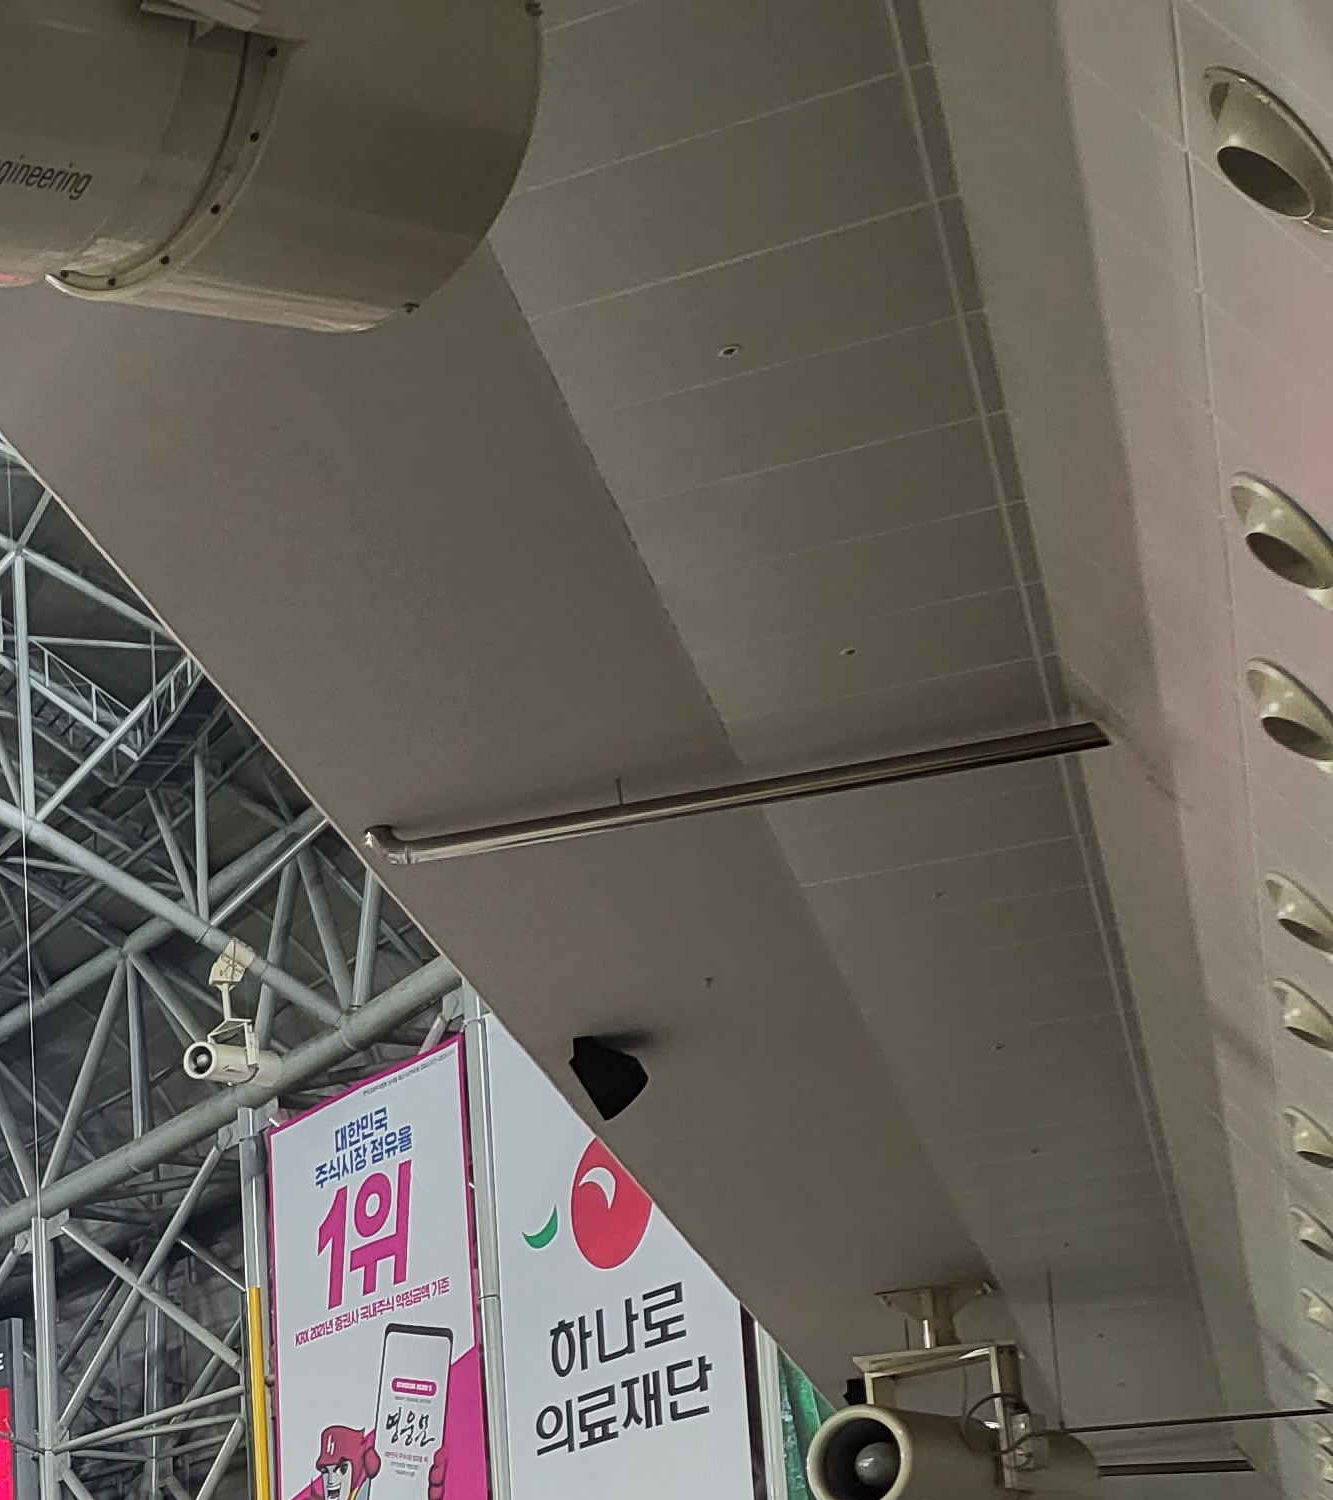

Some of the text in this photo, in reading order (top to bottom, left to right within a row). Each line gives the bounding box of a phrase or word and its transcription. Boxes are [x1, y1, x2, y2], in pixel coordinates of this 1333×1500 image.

[315, 1125, 412, 1188] 주식시장 점유율
[335, 1107, 387, 1153] 대한민국
[318, 1160, 411, 1310] 1위
[335, 1308, 359, 1332] 증권사
[360, 1296, 394, 1321] 국내주식
[432, 1276, 450, 1297] 기준
[549, 1281, 687, 1378] 하나로
[536, 1355, 713, 1457] 의료재단
